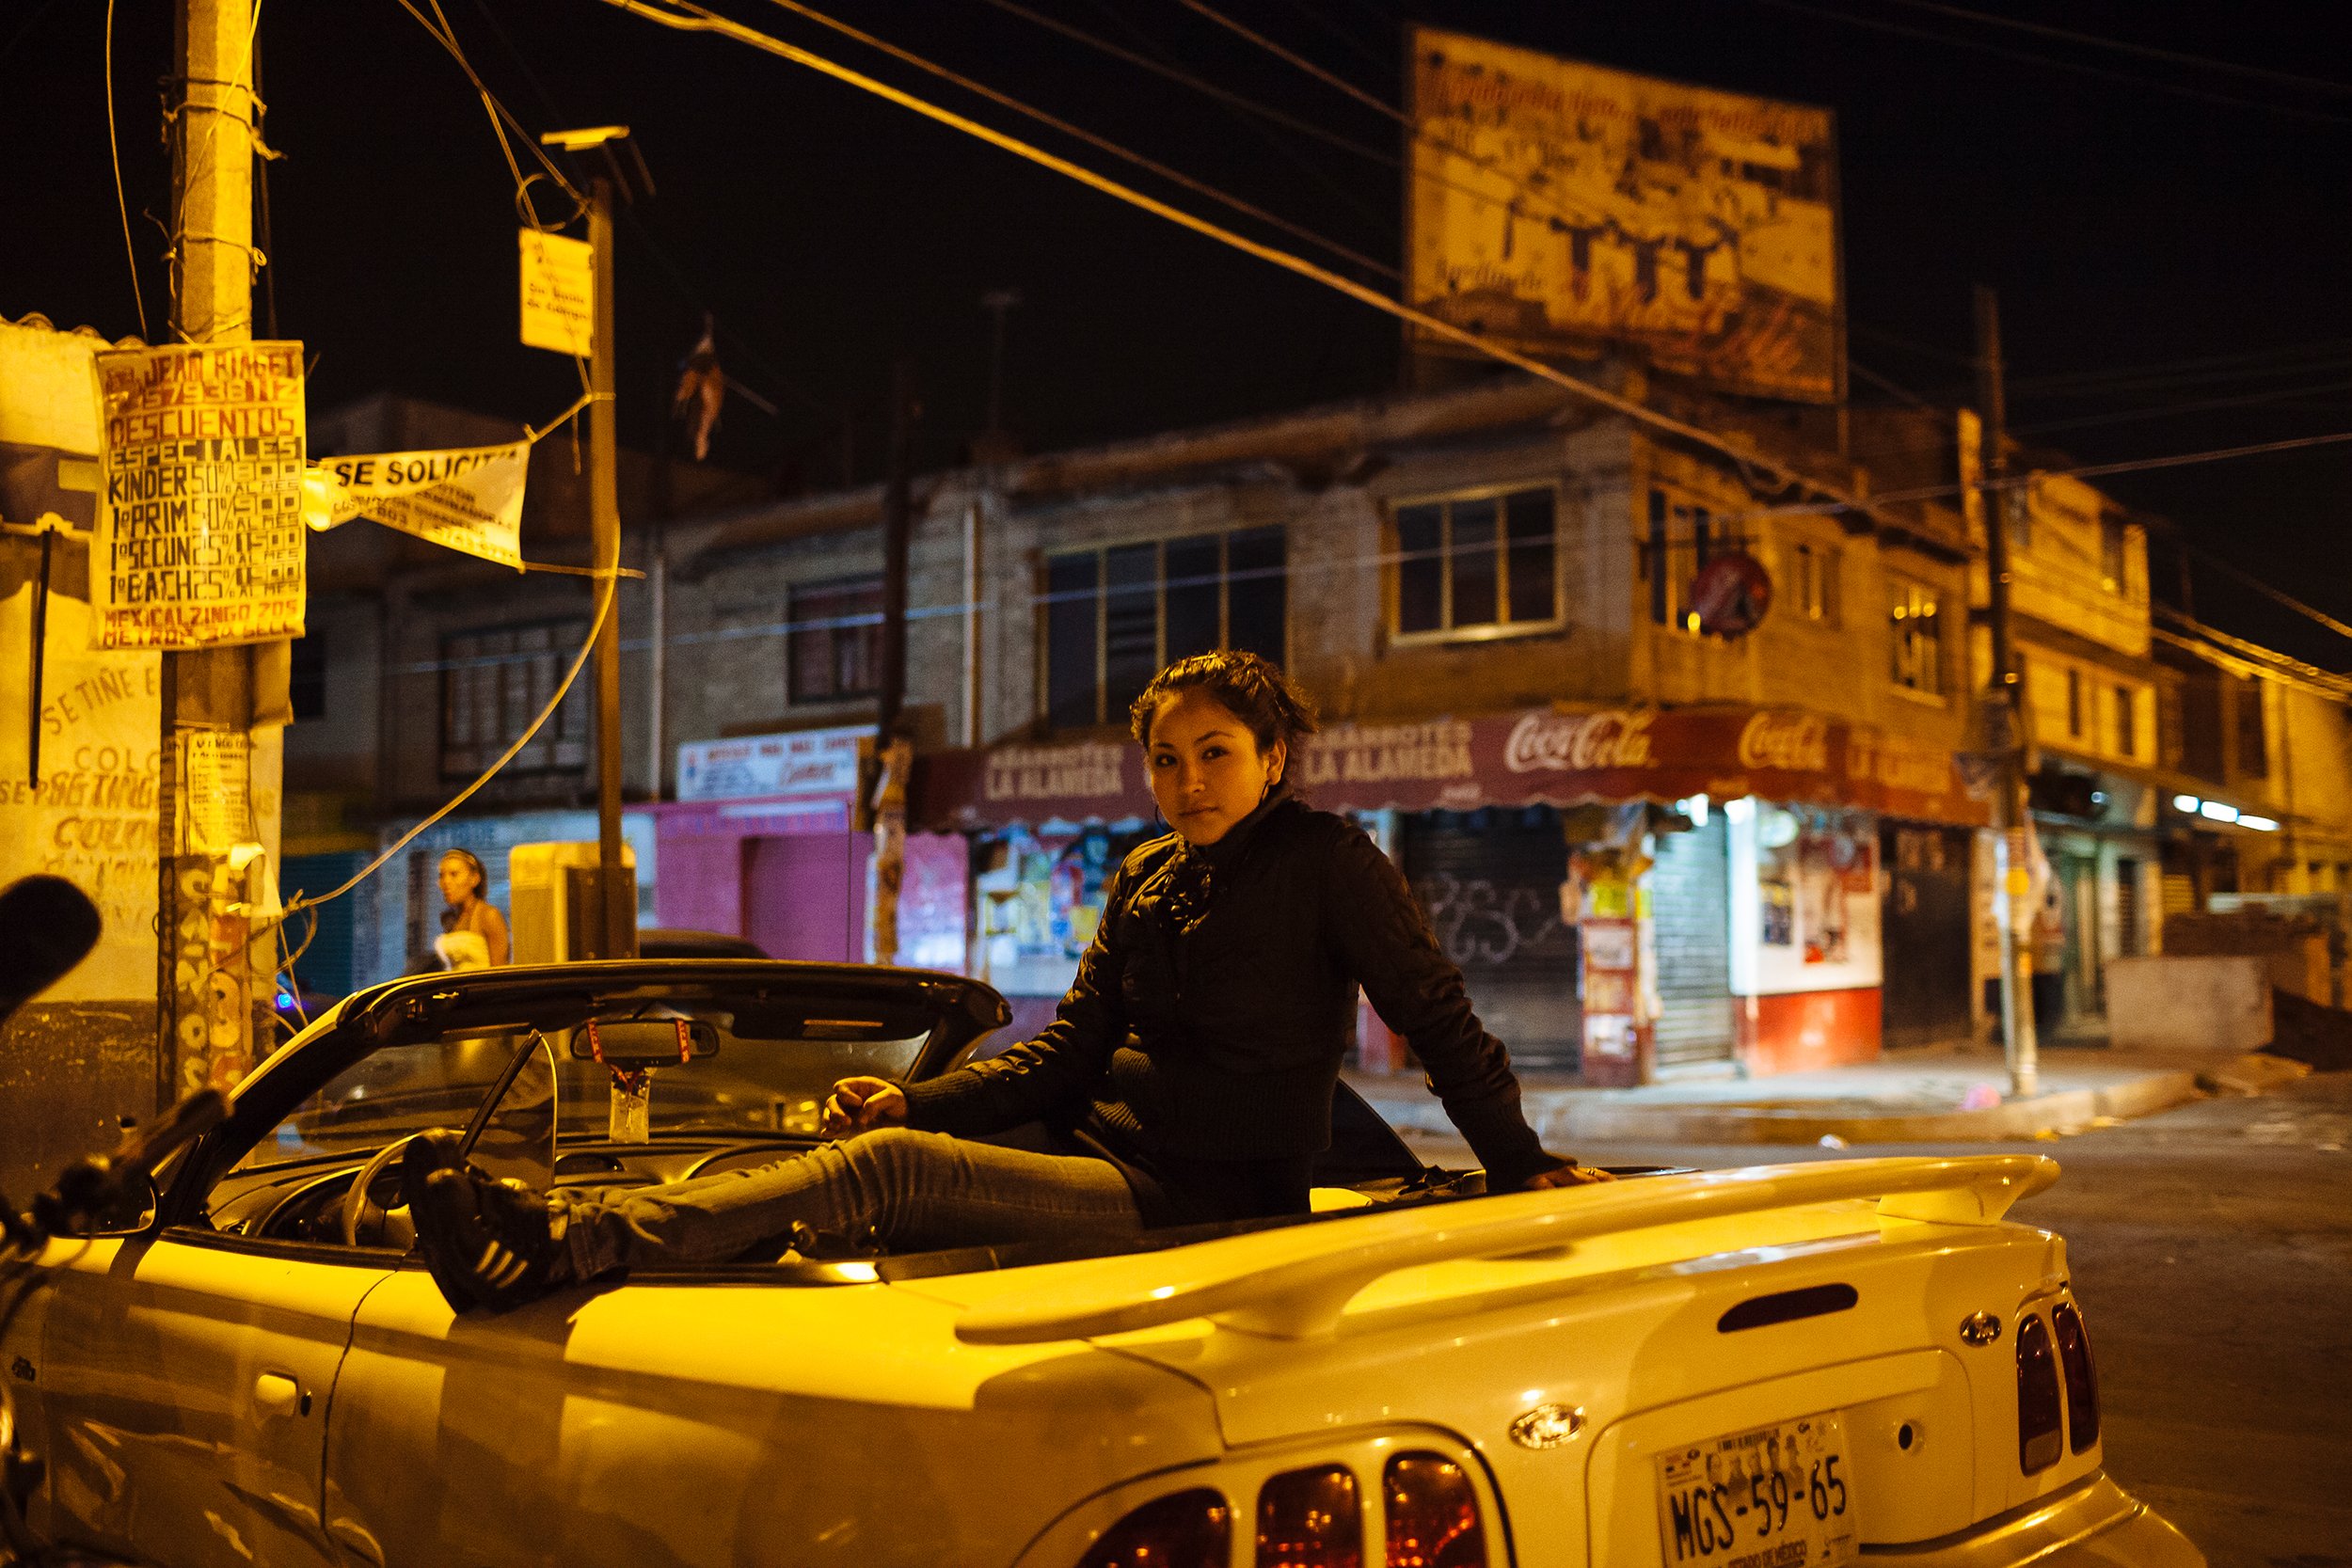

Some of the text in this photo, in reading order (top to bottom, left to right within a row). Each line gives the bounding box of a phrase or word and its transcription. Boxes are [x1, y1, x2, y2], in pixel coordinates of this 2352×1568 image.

[109, 407, 294, 448] DESCUENTOS
[109, 436, 296, 470] ESPECIALES
[108, 467, 187, 504] KINDER
[333, 460, 376, 487] SE
[41, 693, 80, 736] SE
[75, 666, 135, 711] TIÑE
[987, 767, 1015, 800] LA
[1304, 749, 1338, 784] LA
[1670, 1454, 1847, 1562] MGS-59-65
